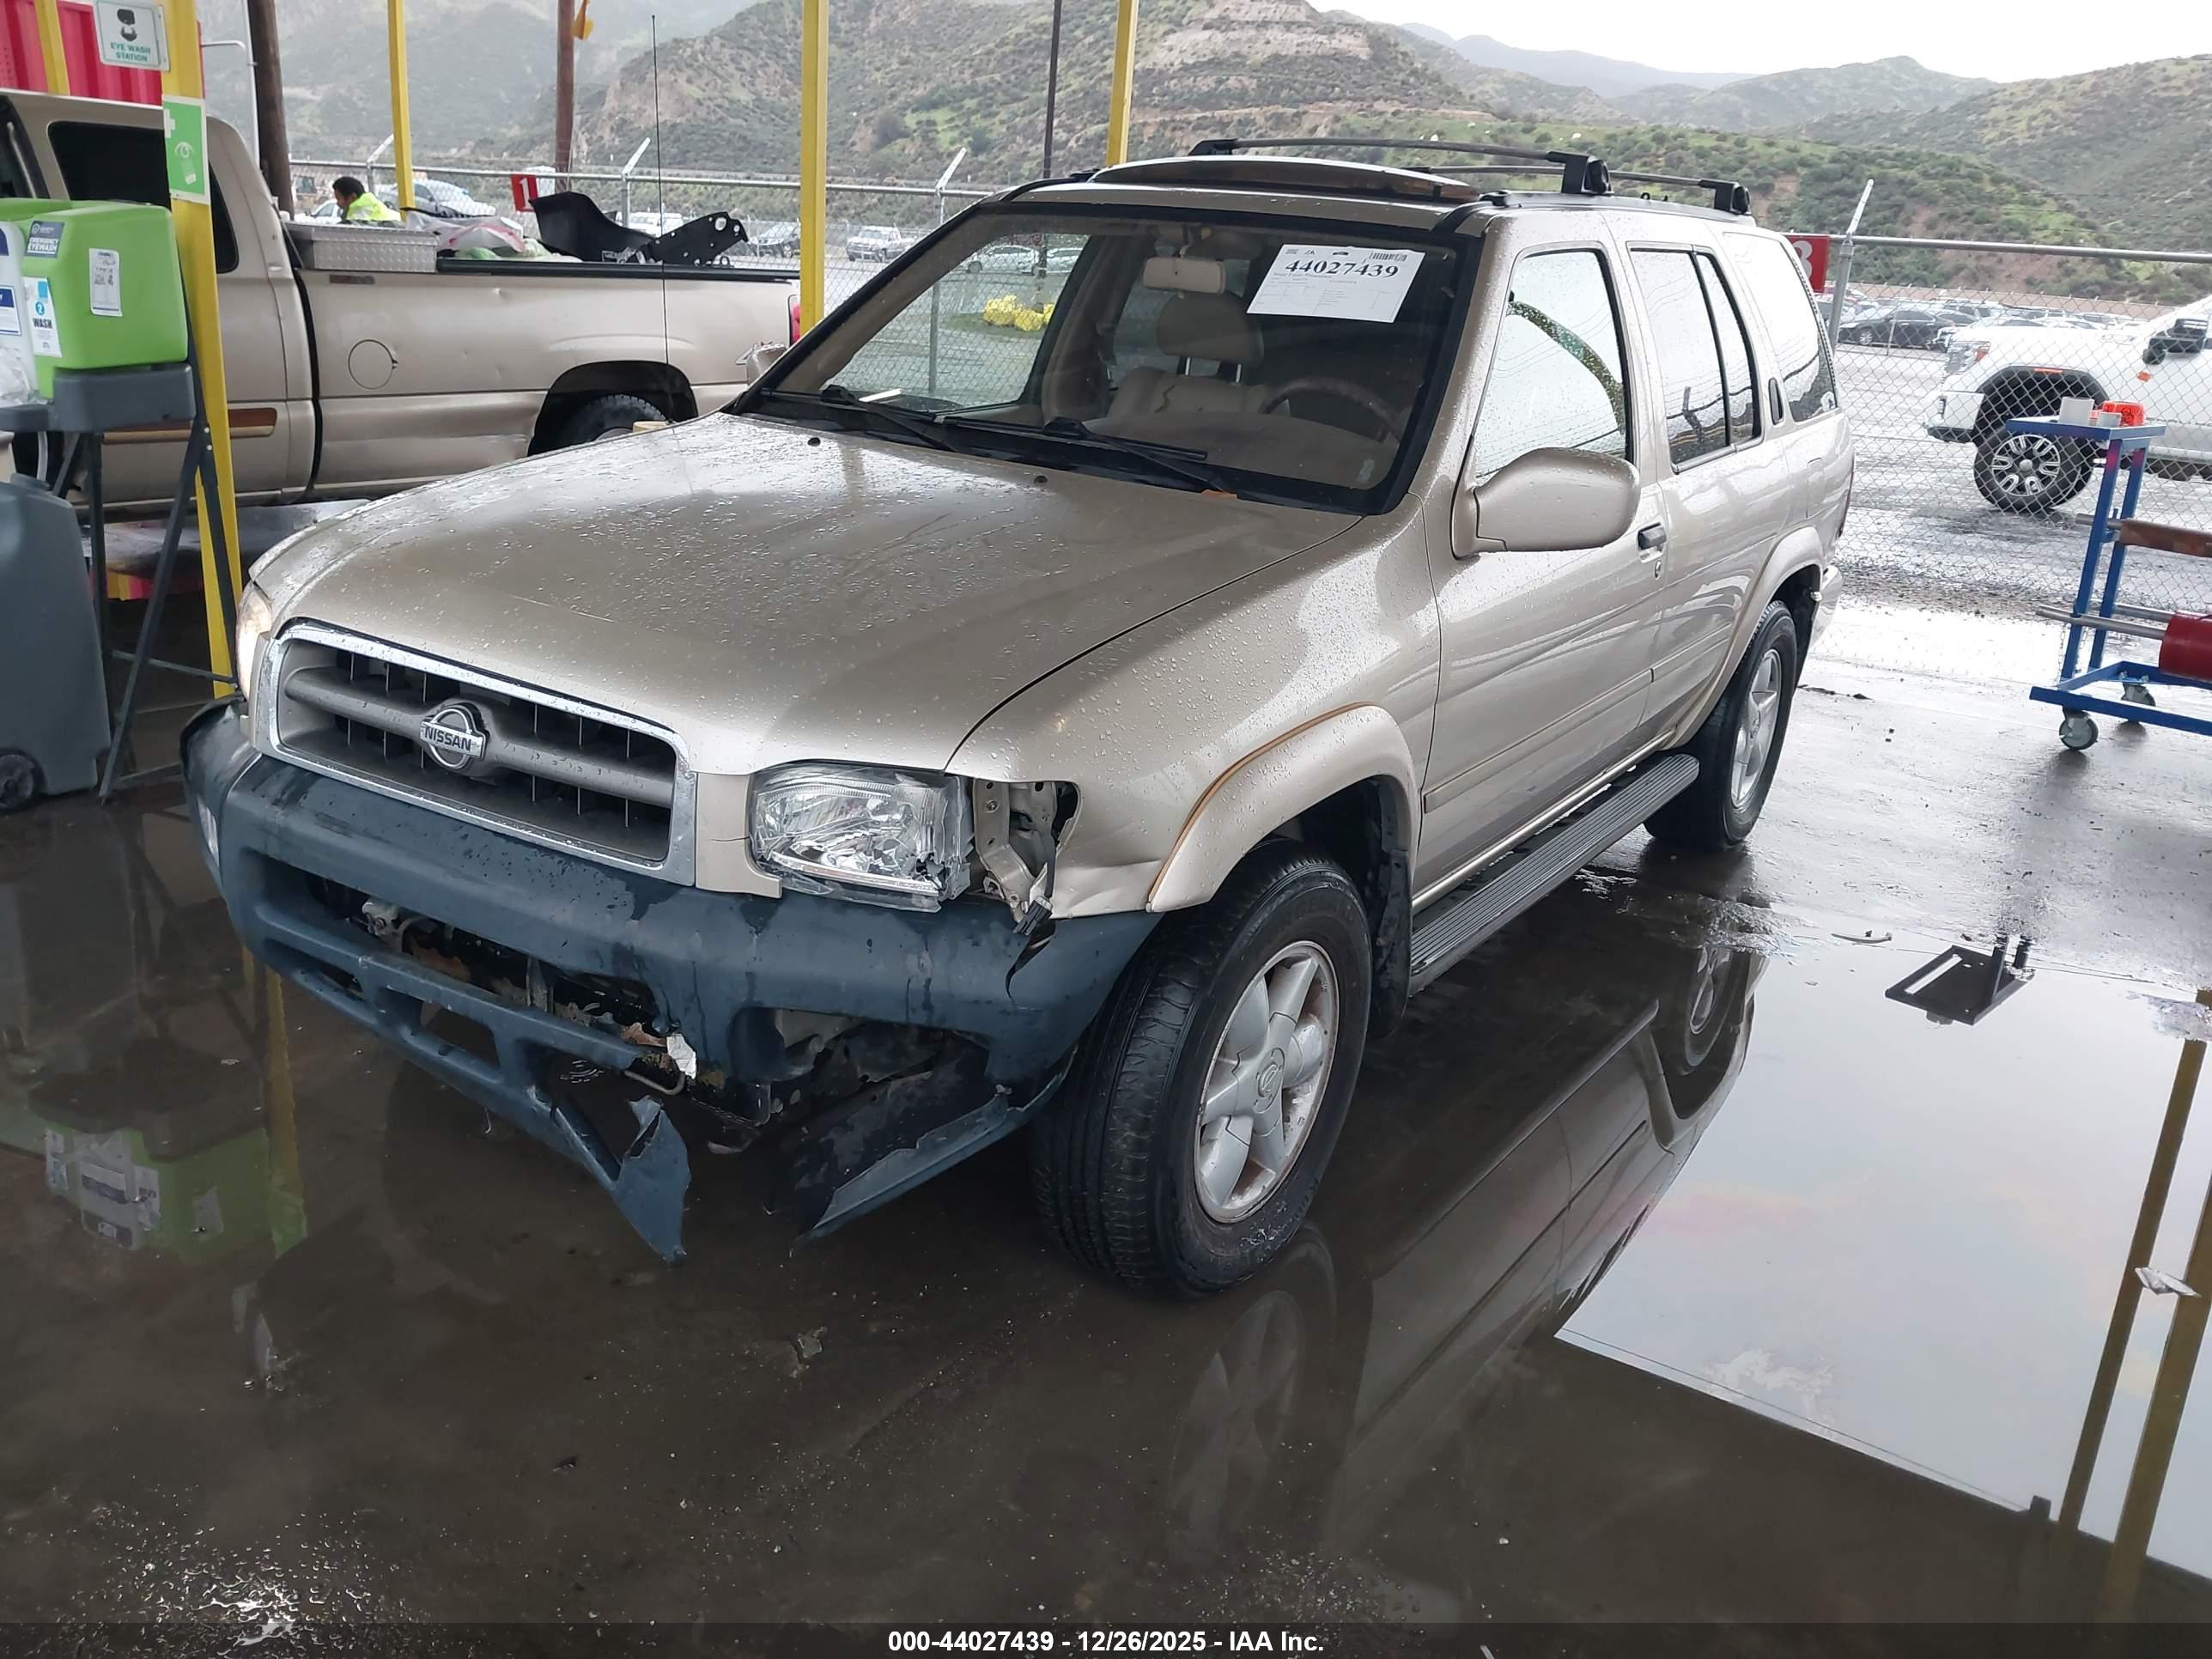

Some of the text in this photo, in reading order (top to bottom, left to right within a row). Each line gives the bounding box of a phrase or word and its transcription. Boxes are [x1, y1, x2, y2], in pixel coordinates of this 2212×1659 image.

[110, 42, 151, 54] EYE WASH
[116, 52, 148, 62] STATION
[519, 177, 534, 210] 1
[1285, 259, 1399, 277] 44027439
[33, 318, 52, 328] WASH
[424, 726, 471, 751] NISSAN
